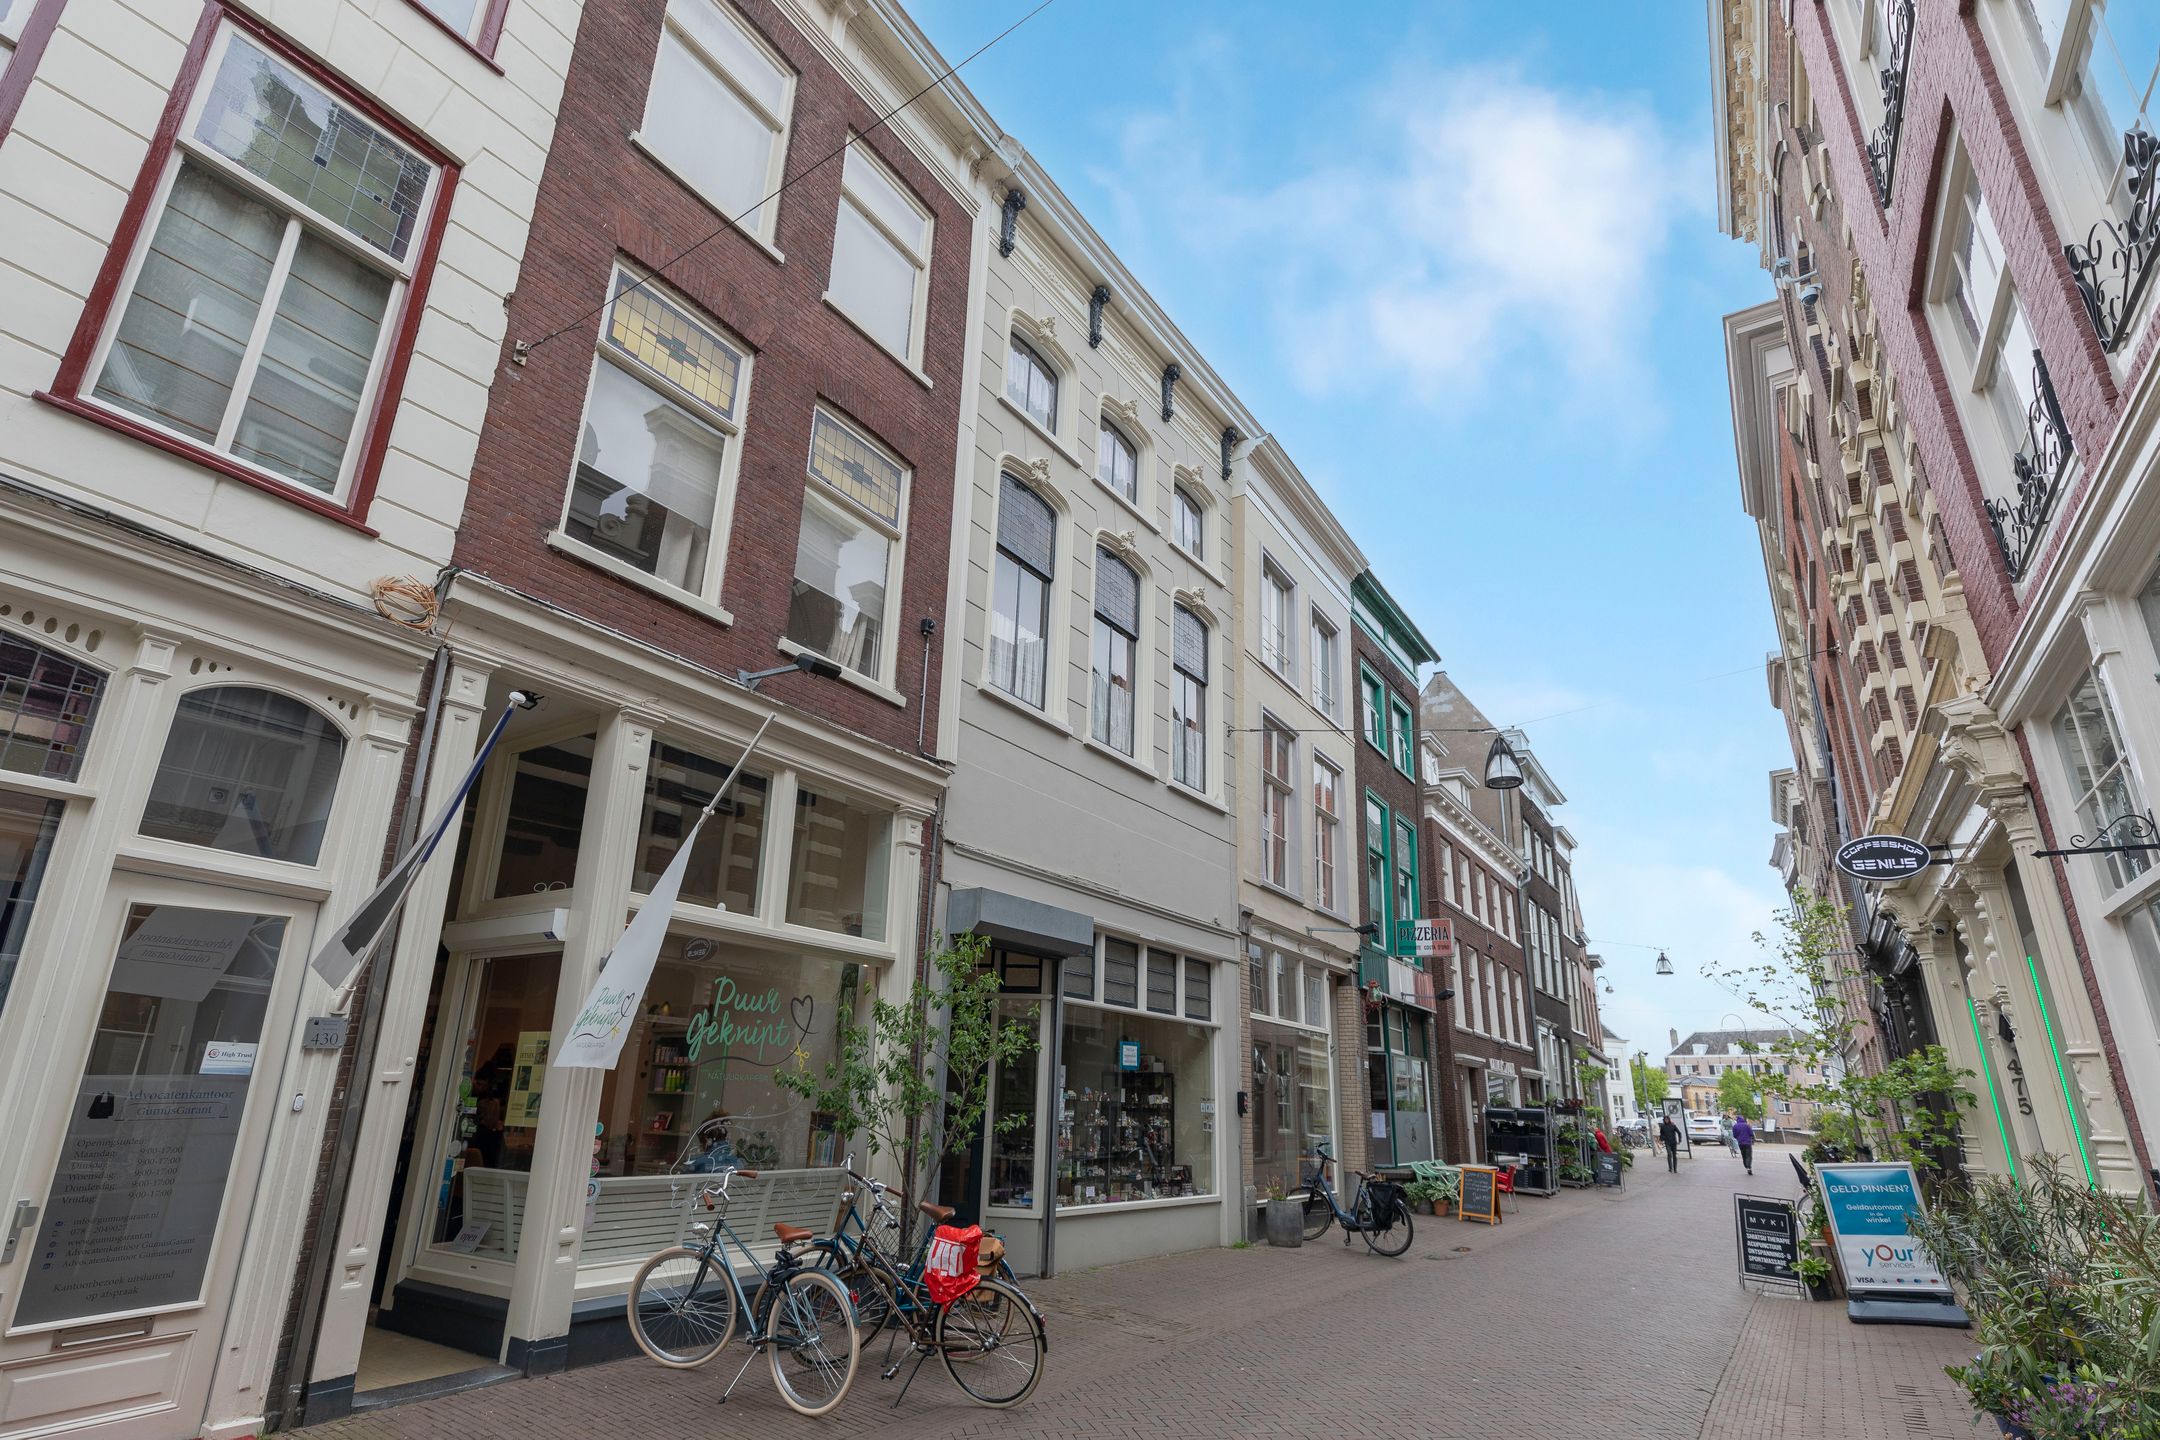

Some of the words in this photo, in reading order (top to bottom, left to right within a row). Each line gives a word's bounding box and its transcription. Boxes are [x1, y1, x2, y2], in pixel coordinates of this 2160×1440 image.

[1842, 840, 1924, 859] COFFEESHOP
[1852, 857, 1918, 870] GENIUS
[1400, 926, 1449, 941] PIZZERIA
[714, 975, 782, 1017] Puur
[311, 1032, 339, 1046] 430
[220, 1050, 236, 1059] High
[2007, 1059, 2032, 1115] 475
[1830, 1184, 1859, 1193] GELD
[1861, 1184, 1909, 1193] PINNEN?
[1846, 1203, 1904, 1211] Geldautomaat
[1879, 1261, 1916, 1269] services
[53, 1277, 124, 1292] Kantoorbezoek
